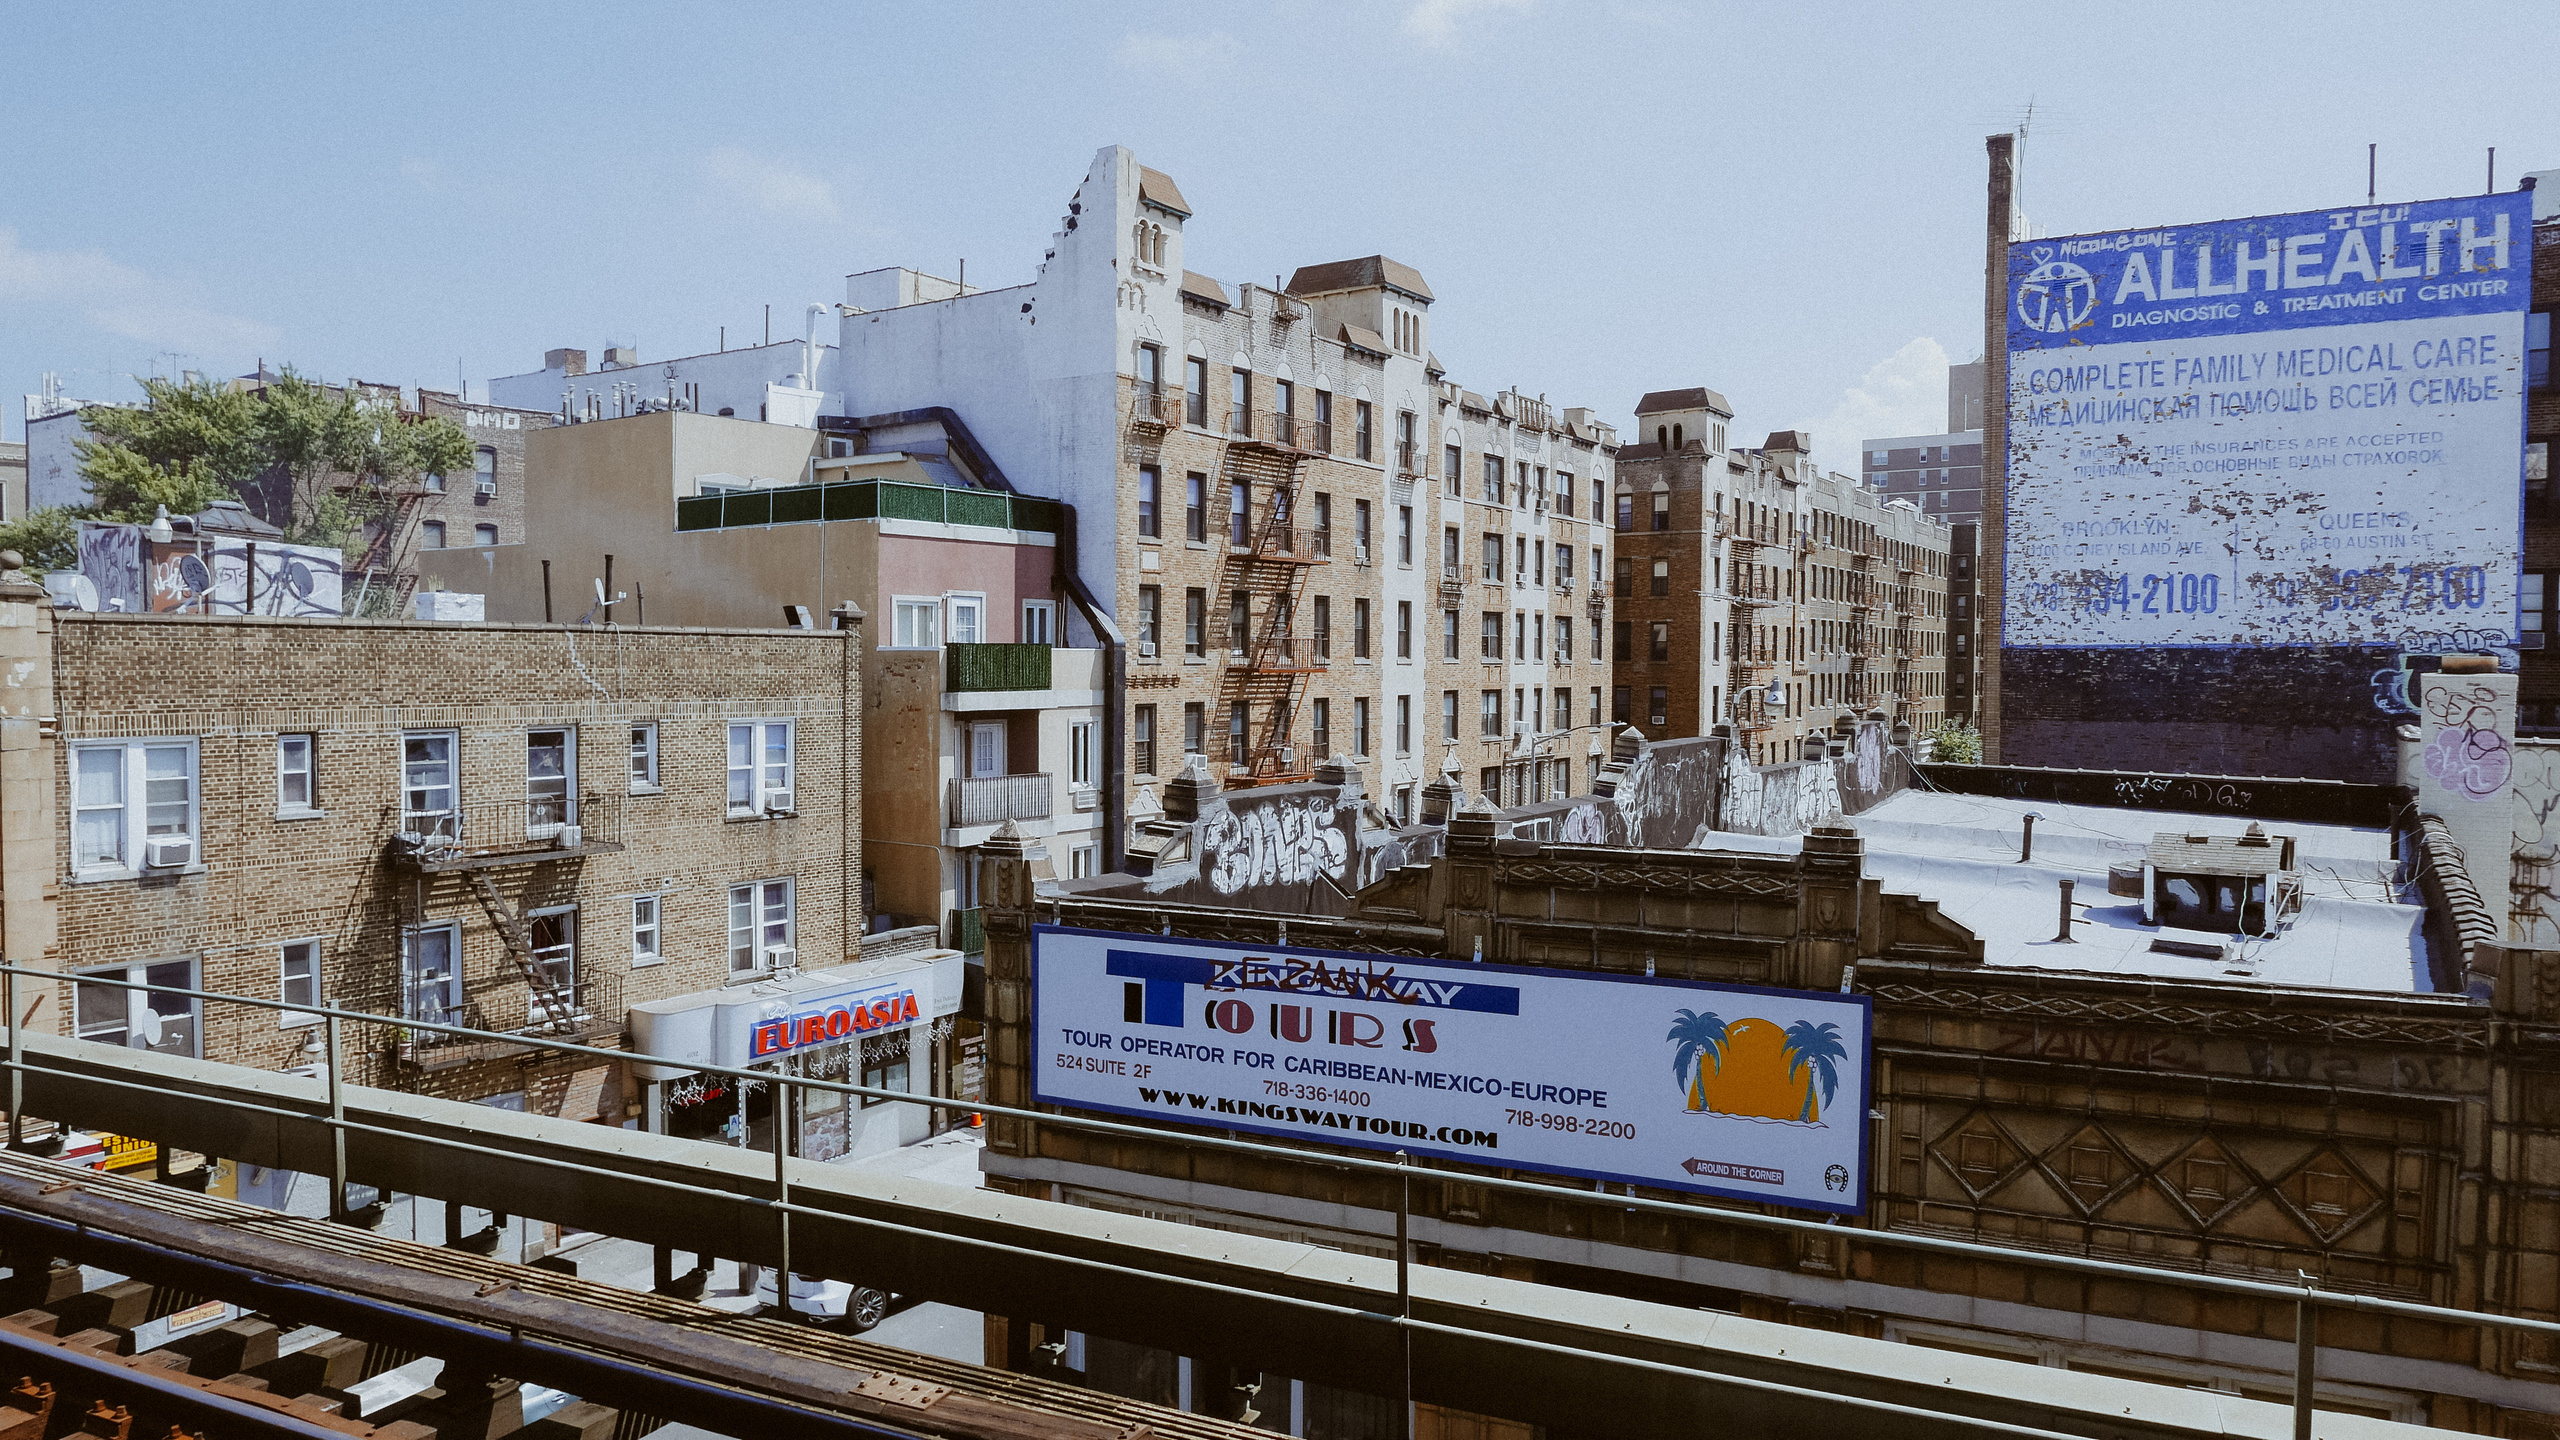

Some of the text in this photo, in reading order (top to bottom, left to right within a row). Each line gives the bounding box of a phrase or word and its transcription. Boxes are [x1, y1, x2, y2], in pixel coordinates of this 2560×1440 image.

[2113, 213, 2510, 305] ALLHEALTH
[2112, 279, 2509, 329] DIAGNOSTIC & TREATMENT CENTER
[2029, 334, 2497, 395] COMPLETE FAMILY MEDICAL CARE
[2329, 376, 2397, 410] ВСЕЙ
[2408, 375, 2499, 407] СЕМЬЕ
[2154, 444, 2186, 457] THE
[2190, 438, 2299, 456] INSURANCES
[2304, 436, 2339, 450] ARE
[2345, 430, 2444, 447] ACCEPTED
[2342, 449, 2443, 467] СТРАХОВОК
[2062, 518, 2170, 537] BROOKLYN
[2319, 511, 2410, 531] QUEENS
[2117, 541, 2171, 556] ISLAND
[2345, 534, 2406, 549] AUSTIN
[754, 990, 921, 1057] EUROASIA
[1056, 1053, 1152, 1079] 524 SUITE 2F
[1062, 1028, 1608, 1109] TOUR OPERATOR FOR CARIBBEAN-MEXICO-EUROPE
[1262, 1079, 1371, 1107] 718-336-1400
[1138, 1086, 1498, 1149] WWW.KINGSWAYTOUR.COM
[1504, 1108, 1636, 1140] 718-998-2200
[1696, 1162, 1783, 1183] AROUND THE CORNER
